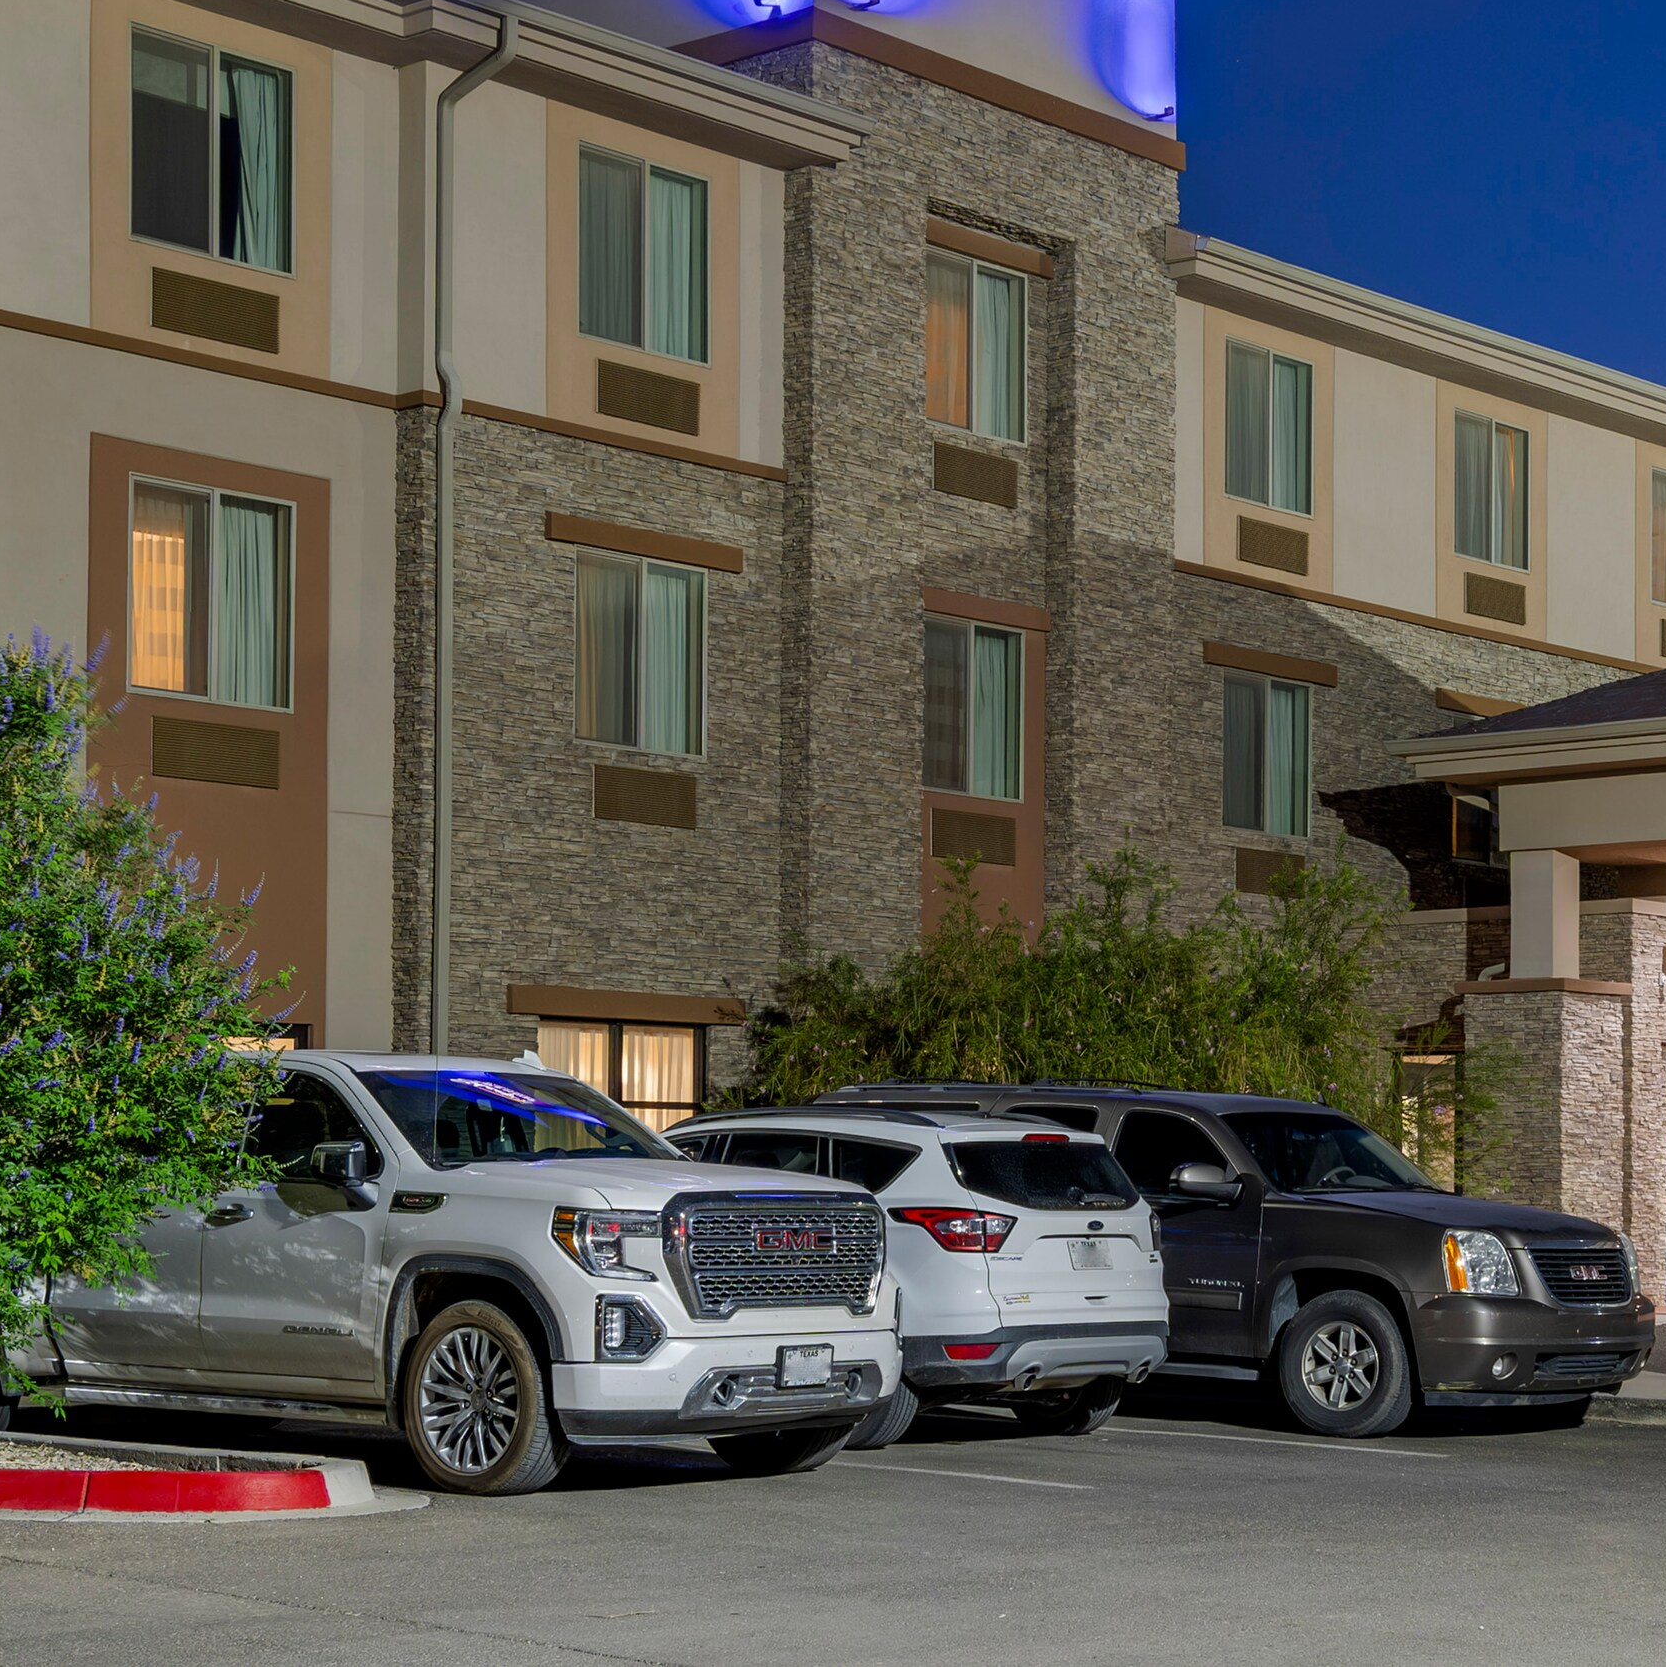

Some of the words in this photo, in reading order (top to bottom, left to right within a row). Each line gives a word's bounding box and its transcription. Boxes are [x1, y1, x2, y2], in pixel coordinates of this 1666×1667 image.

[757, 1230, 833, 1250] GMC
[1569, 1265, 1608, 1280] GMC
[799, 1349, 819, 1358] TEXAS
